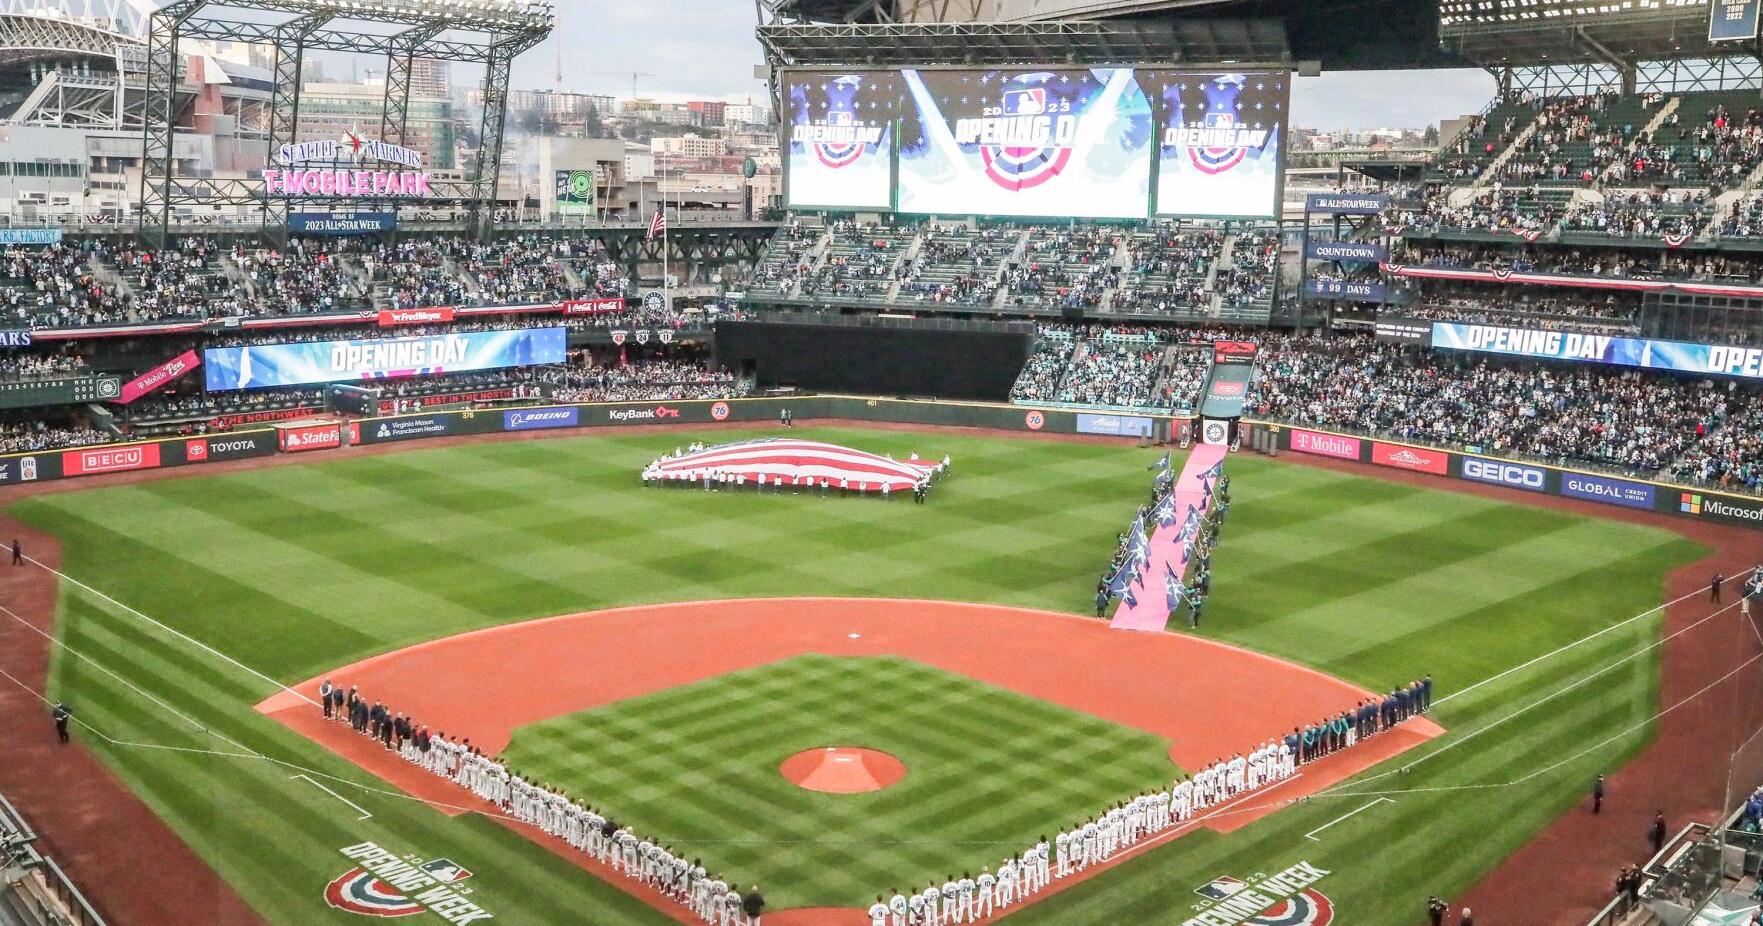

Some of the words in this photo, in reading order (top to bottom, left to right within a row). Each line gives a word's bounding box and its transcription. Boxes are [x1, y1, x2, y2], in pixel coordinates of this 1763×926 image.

[1725, 12, 1744, 21] 2022
[983, 107, 1002, 116] 20
[1047, 103, 1070, 113] 23
[793, 125, 856, 142] OPENING
[856, 127, 882, 142] DAY
[956, 115, 1051, 146] OPENING
[1164, 128, 1237, 147] OPENING
[1238, 129, 1267, 147] DAY
[280, 140, 337, 164] SEATTLE
[366, 141, 422, 168] MARINERS
[262, 169, 371, 198] T-MOBILE
[372, 171, 432, 198] PARK
[1359, 200, 1380, 209] WEEK
[305, 220, 325, 231] 2023
[359, 219, 382, 231] WEEK
[20, 230, 55, 243] FACTORY
[1316, 247, 1375, 258] COUNTDOWN
[1328, 284, 1341, 293] 99
[1346, 284, 1371, 295] DAYS
[639, 334, 647, 342] 24
[1468, 324, 1562, 356] OPENING
[1565, 334, 1613, 360] DAY
[331, 341, 426, 373] OPENING
[430, 338, 469, 364] DAY
[1707, 345, 1763, 377] OPE
[144, 371, 168, 386] Mobile
[461, 393, 479, 401] THE
[221, 415, 244, 425] THE
[247, 408, 313, 422] NORTHWEST
[525, 411, 571, 421] BOEING
[609, 409, 655, 421] KeyBank
[714, 407, 726, 415] 76
[392, 420, 414, 430] Virginia
[415, 419, 434, 427] Mason
[1030, 416, 1041, 425] 76
[392, 426, 424, 436] Franciscan
[423, 424, 445, 432] Health
[210, 440, 256, 453] TOYOTA
[1311, 436, 1353, 455] Mobile
[88, 452, 138, 466] BECU
[1463, 460, 1543, 487] GEICO
[1568, 480, 1622, 498] GLOBAL
[1624, 488, 1648, 496] CREDIT
[1624, 493, 1645, 501] UNION
[403, 853, 424, 865] 20
[339, 841, 437, 892] OPENING
[414, 885, 494, 926] WEEK
[1255, 860, 1332, 897] WEEK
[1190, 900, 1212, 911] 20
[1246, 872, 1267, 883] 23
